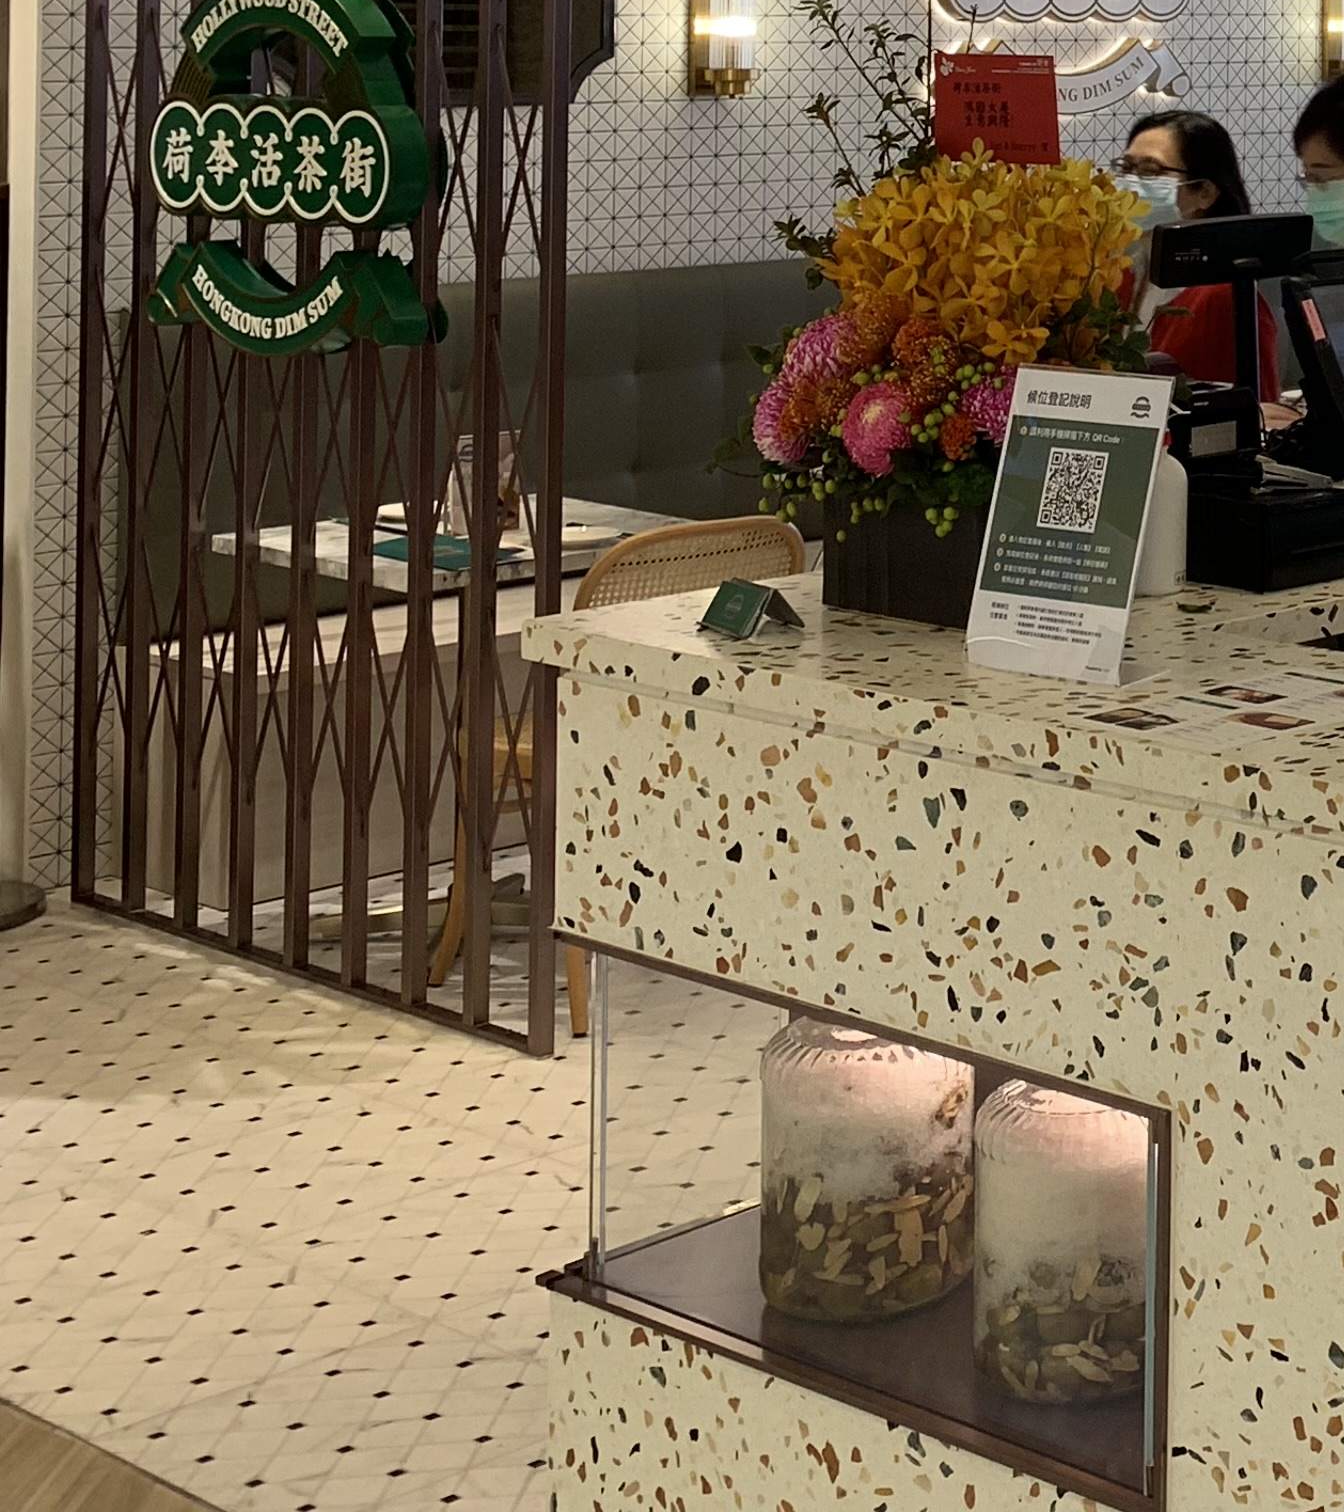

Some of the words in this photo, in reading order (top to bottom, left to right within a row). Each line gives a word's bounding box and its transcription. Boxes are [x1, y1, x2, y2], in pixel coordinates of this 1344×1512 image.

[1083, 79, 1113, 100] DIM
[1115, 56, 1145, 88] SUM
[162, 127, 377, 198] 荷李活茶街
[191, 264, 273, 340] HONGKONG
[275, 309, 308, 339] DIM
[309, 276, 344, 323] SUM
